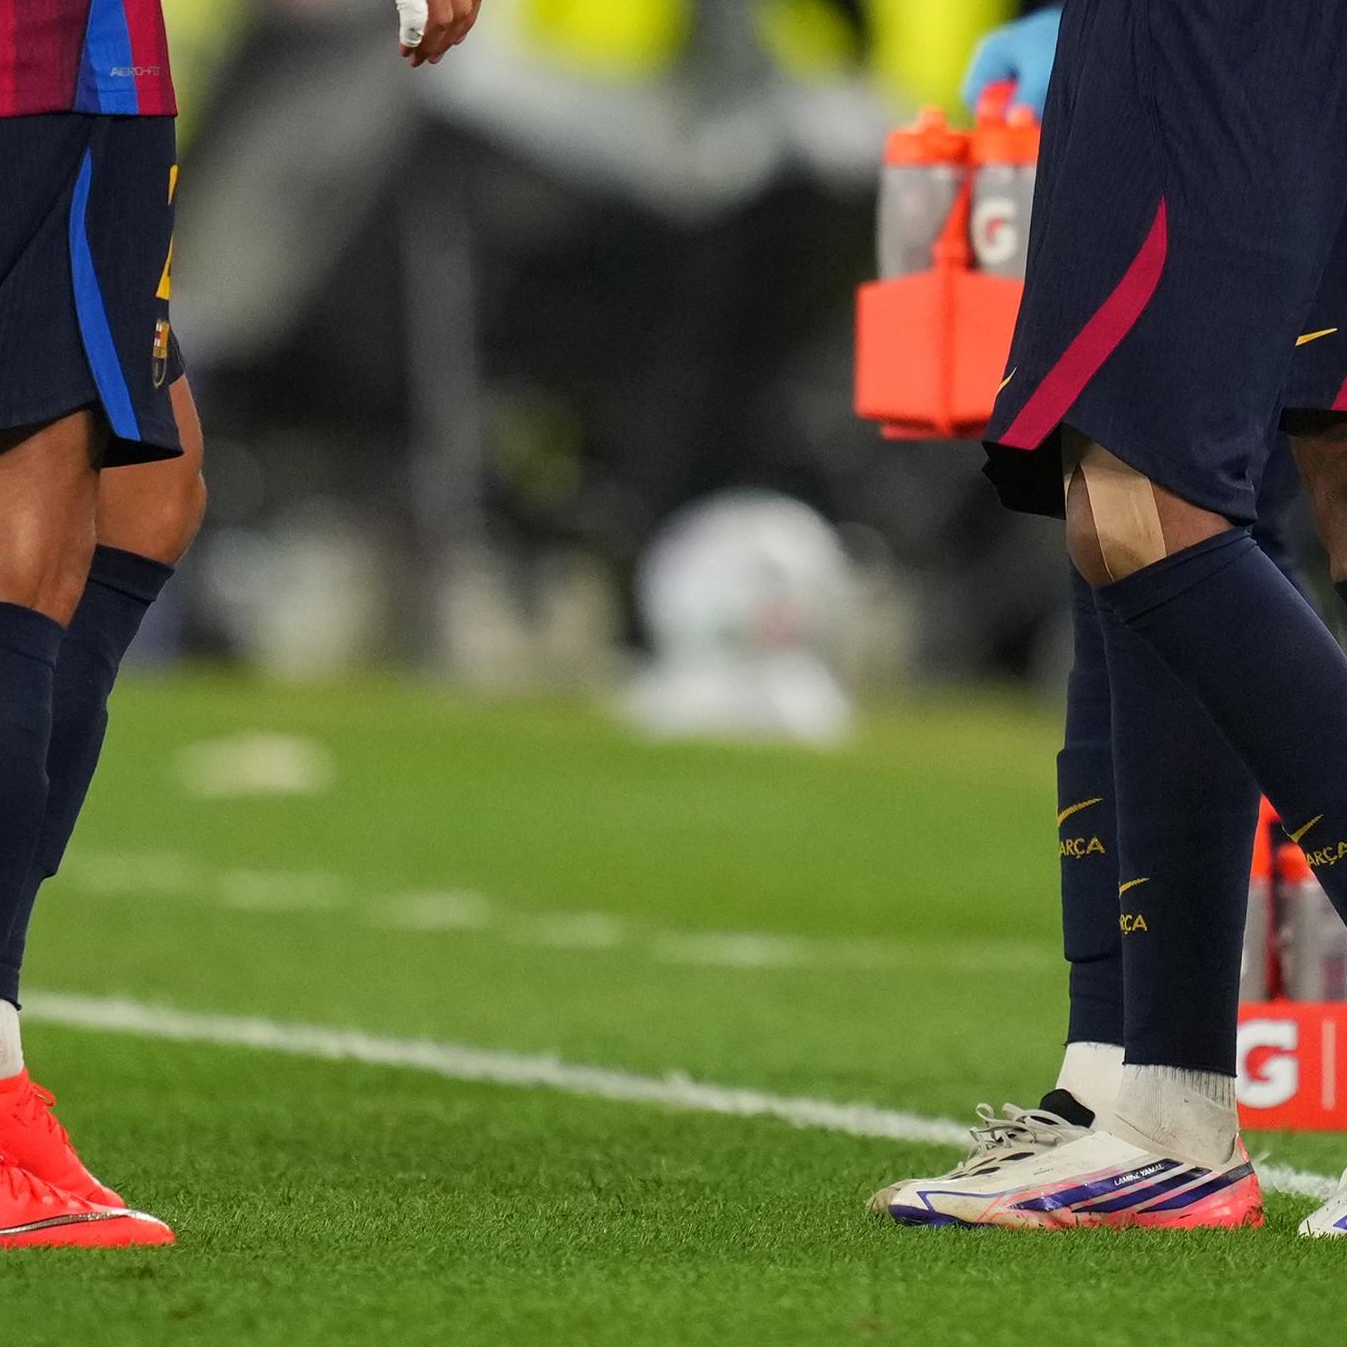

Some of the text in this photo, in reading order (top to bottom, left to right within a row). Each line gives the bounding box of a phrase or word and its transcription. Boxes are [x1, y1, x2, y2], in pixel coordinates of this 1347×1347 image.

[970, 196, 1020, 265] G
[1059, 837, 1106, 859] ARÇA
[1119, 914, 1148, 935] RÇA
[1236, 1018, 1298, 1109] G
